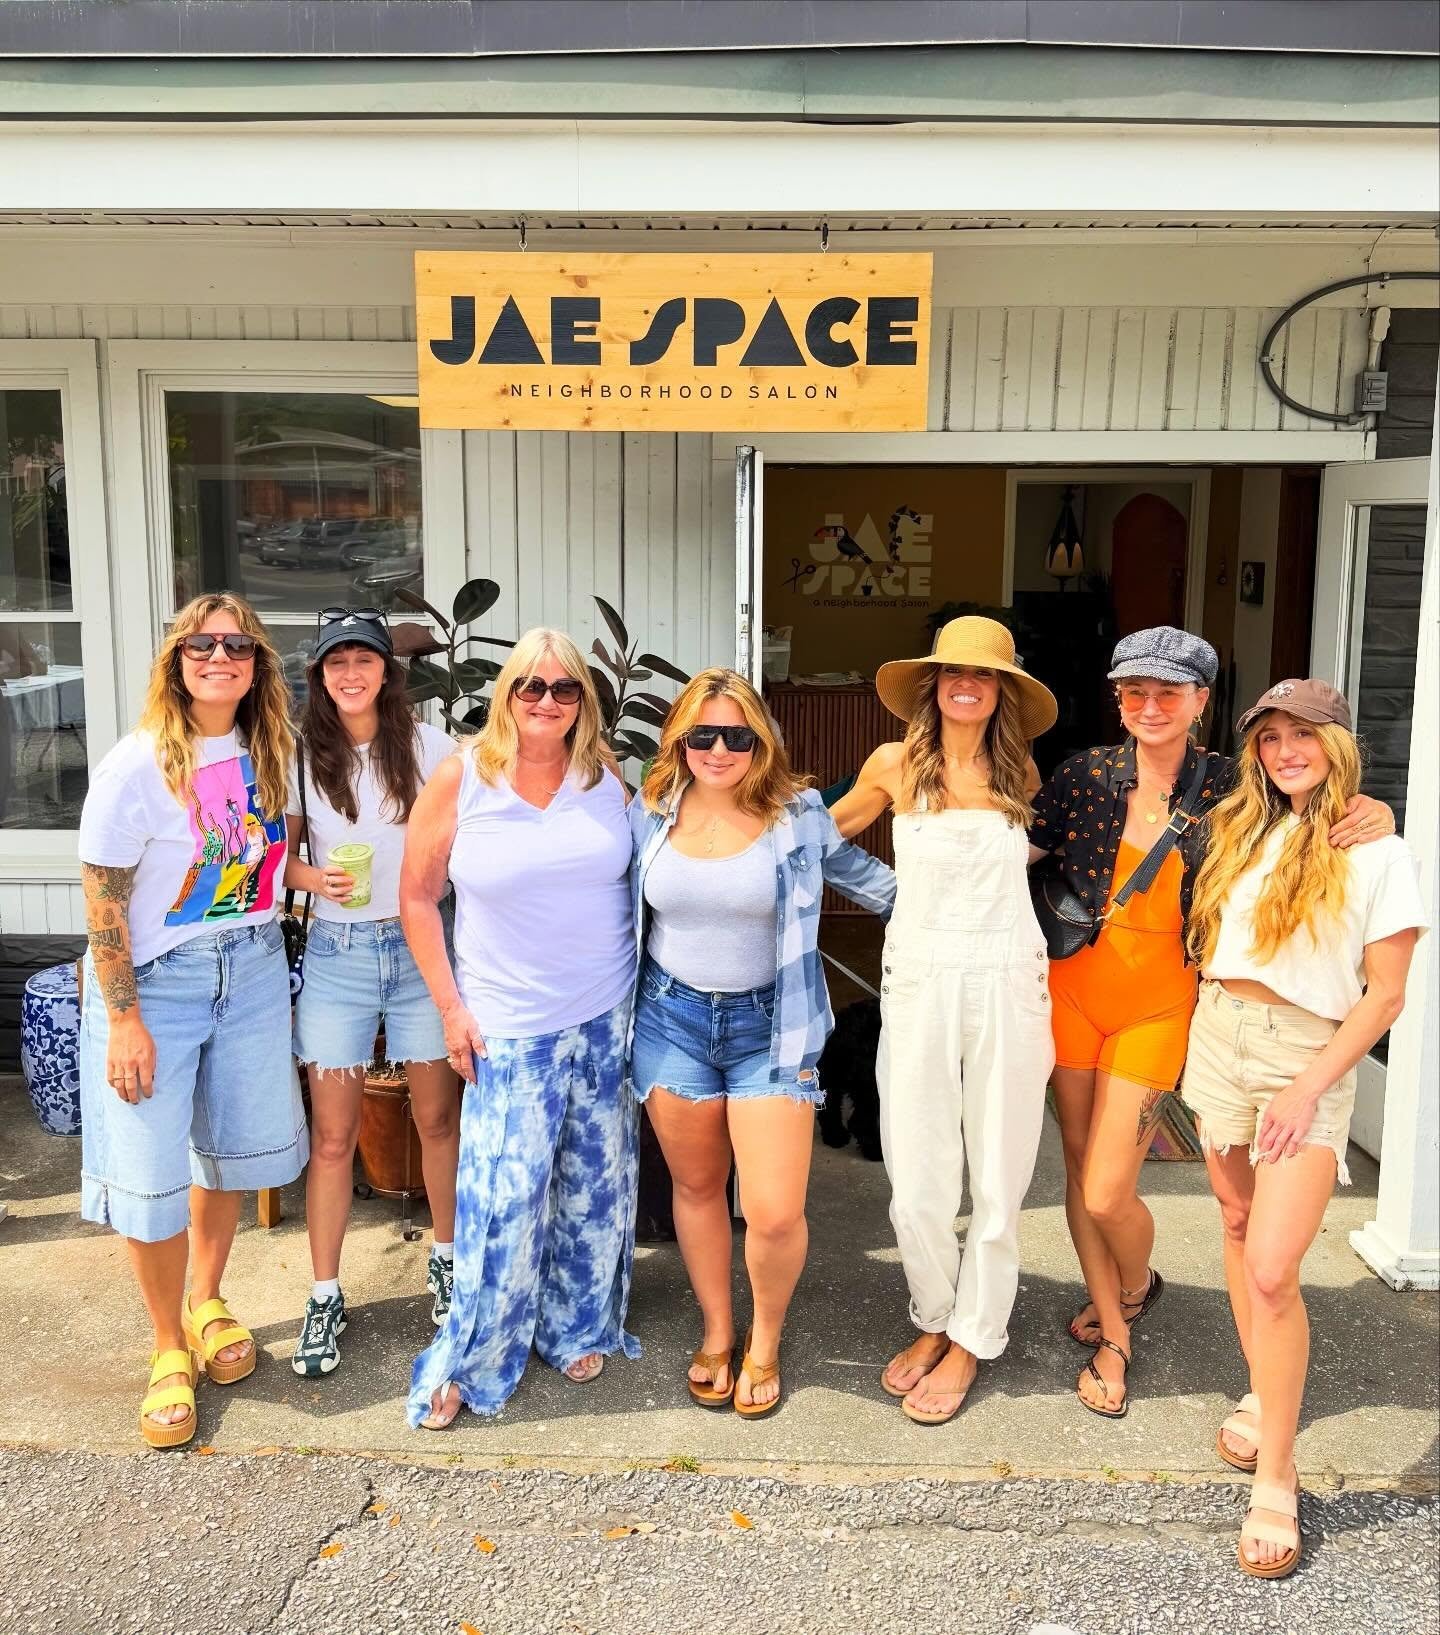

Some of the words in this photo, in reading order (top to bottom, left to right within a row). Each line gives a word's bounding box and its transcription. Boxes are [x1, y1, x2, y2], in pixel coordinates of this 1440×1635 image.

[429, 294, 602, 366] JAE
[629, 294, 920, 368] SPACE
[510, 384, 733, 399] NEIGHBORHOOD
[748, 384, 838, 399] SALON
[809, 513, 934, 562] JAE
[802, 565, 932, 597] SPACE
